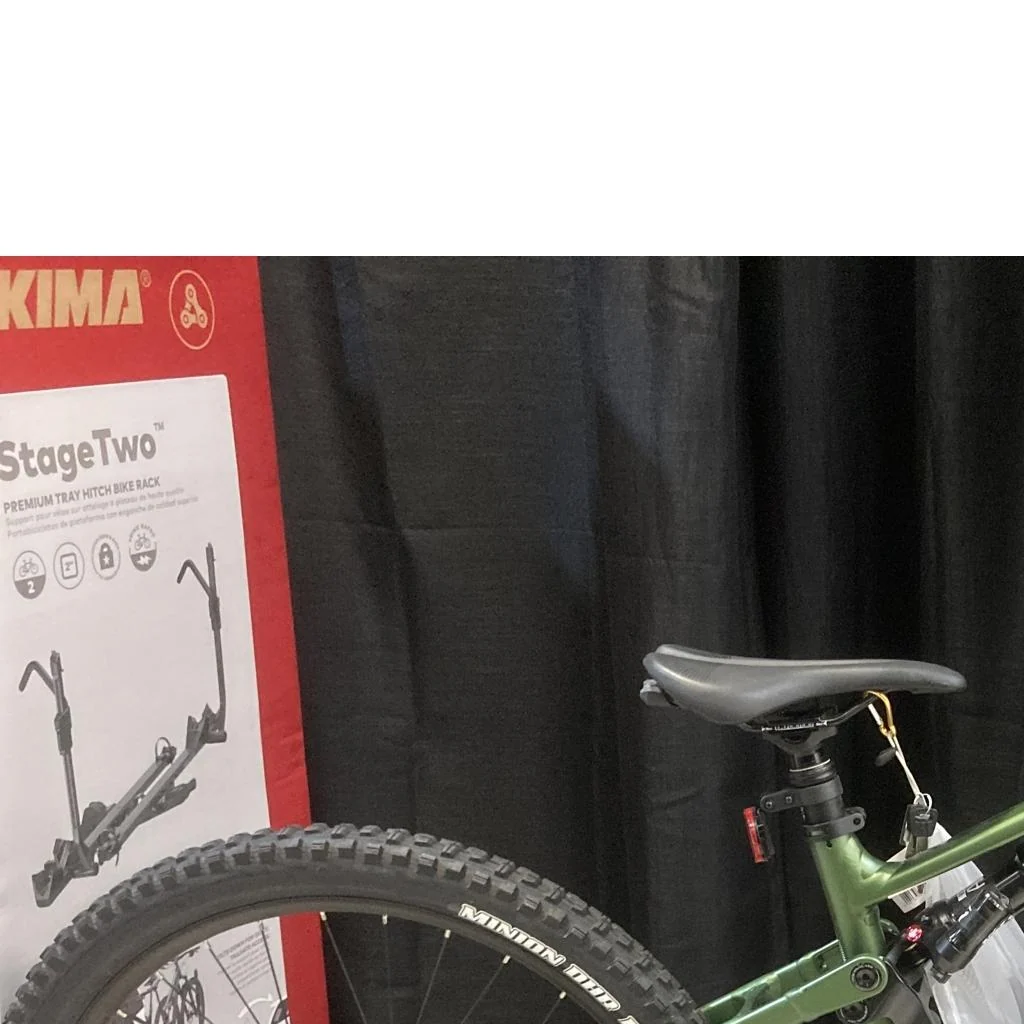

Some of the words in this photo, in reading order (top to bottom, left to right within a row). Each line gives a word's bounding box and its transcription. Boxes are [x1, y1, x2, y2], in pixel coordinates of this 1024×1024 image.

[3, 494, 54, 514] PREMIUM
[55, 488, 80, 504] TRAY
[83, 485, 112, 500] HITCH
[113, 481, 135, 495] BIKE
[136, 476, 161, 491] RACK
[27, 581, 36, 593] 2
[458, 903, 566, 966] MINION
